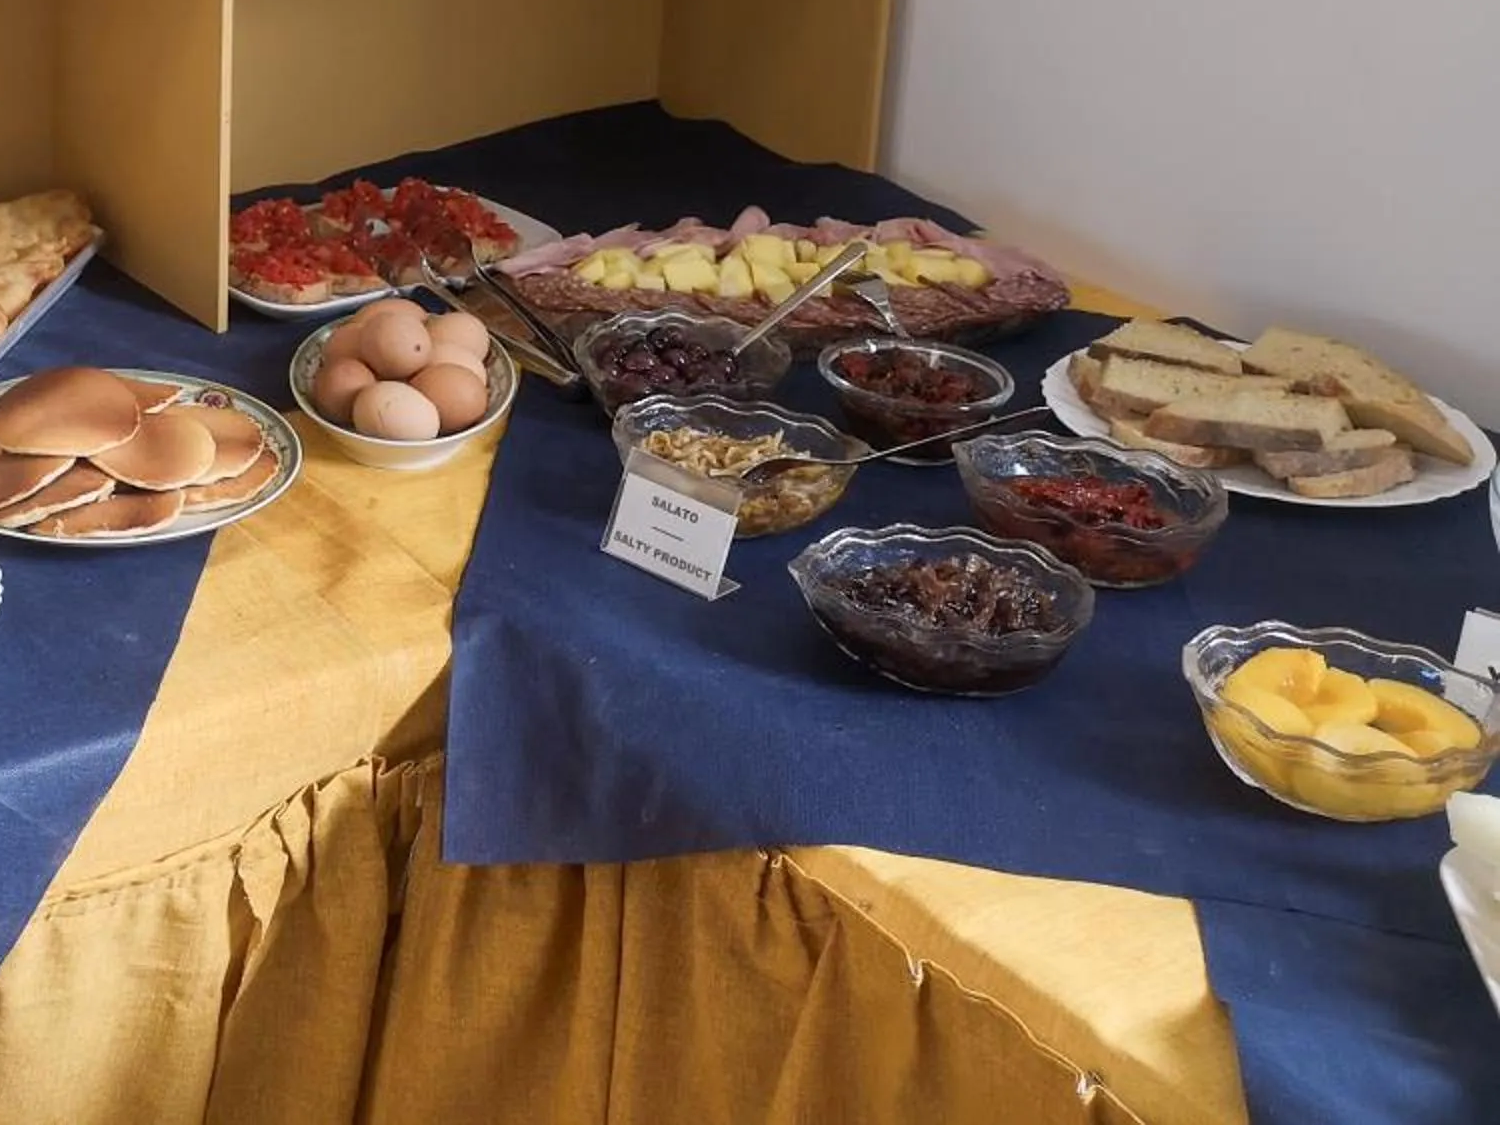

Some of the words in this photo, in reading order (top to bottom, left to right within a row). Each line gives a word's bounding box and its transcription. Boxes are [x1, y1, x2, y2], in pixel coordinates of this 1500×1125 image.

[651, 495, 700, 524] SALATO
[612, 530, 652, 554] SALTY
[653, 548, 713, 582] PRODUCT
